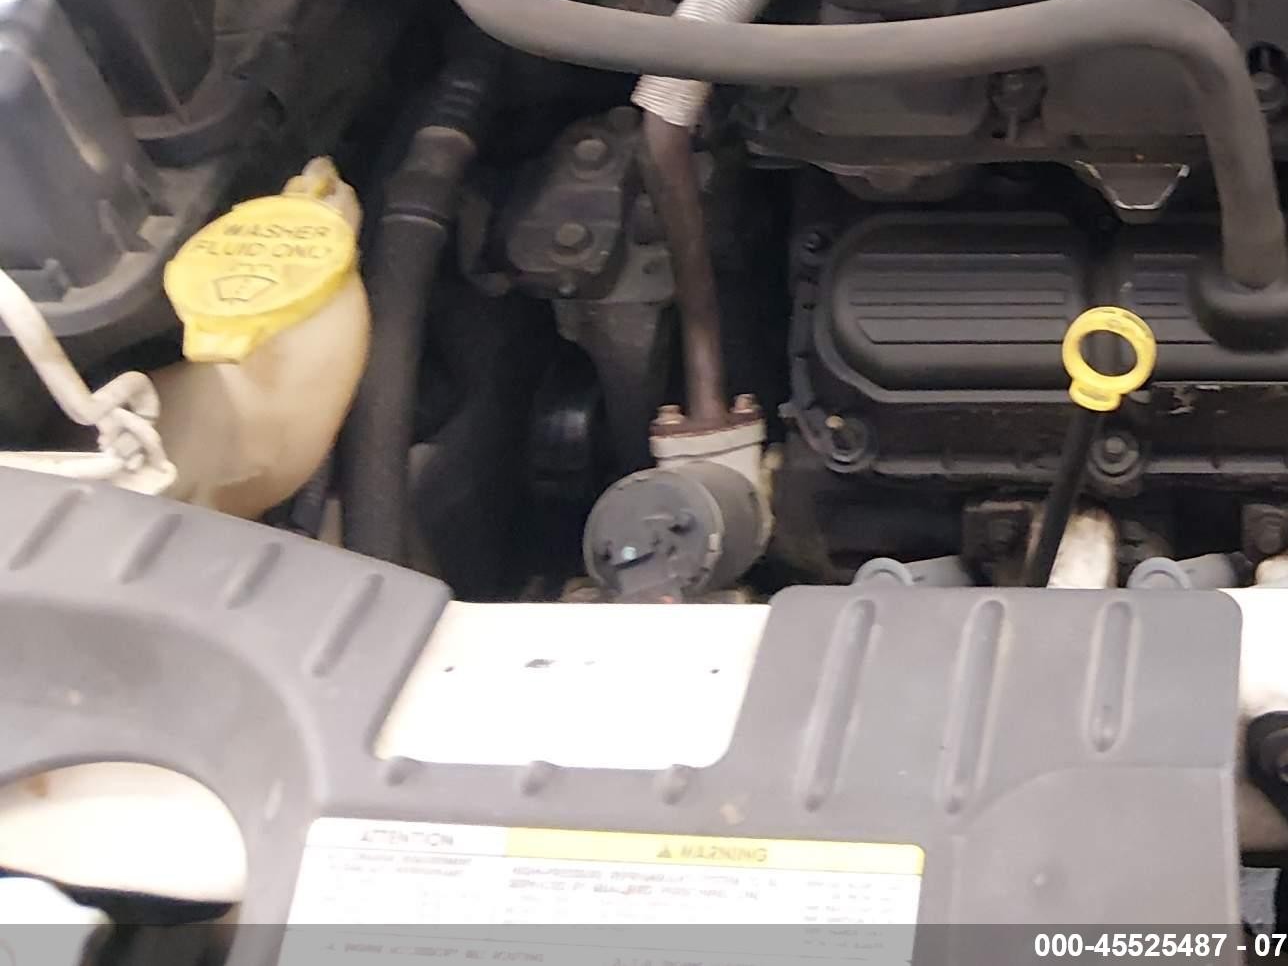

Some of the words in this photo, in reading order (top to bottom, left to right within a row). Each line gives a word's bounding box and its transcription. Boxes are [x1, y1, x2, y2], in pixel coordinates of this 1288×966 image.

[225, 224, 330, 240] WASHER
[192, 238, 266, 258] FLUID
[361, 828, 454, 847] ATTENTION
[679, 845, 768, 863] WARNING
